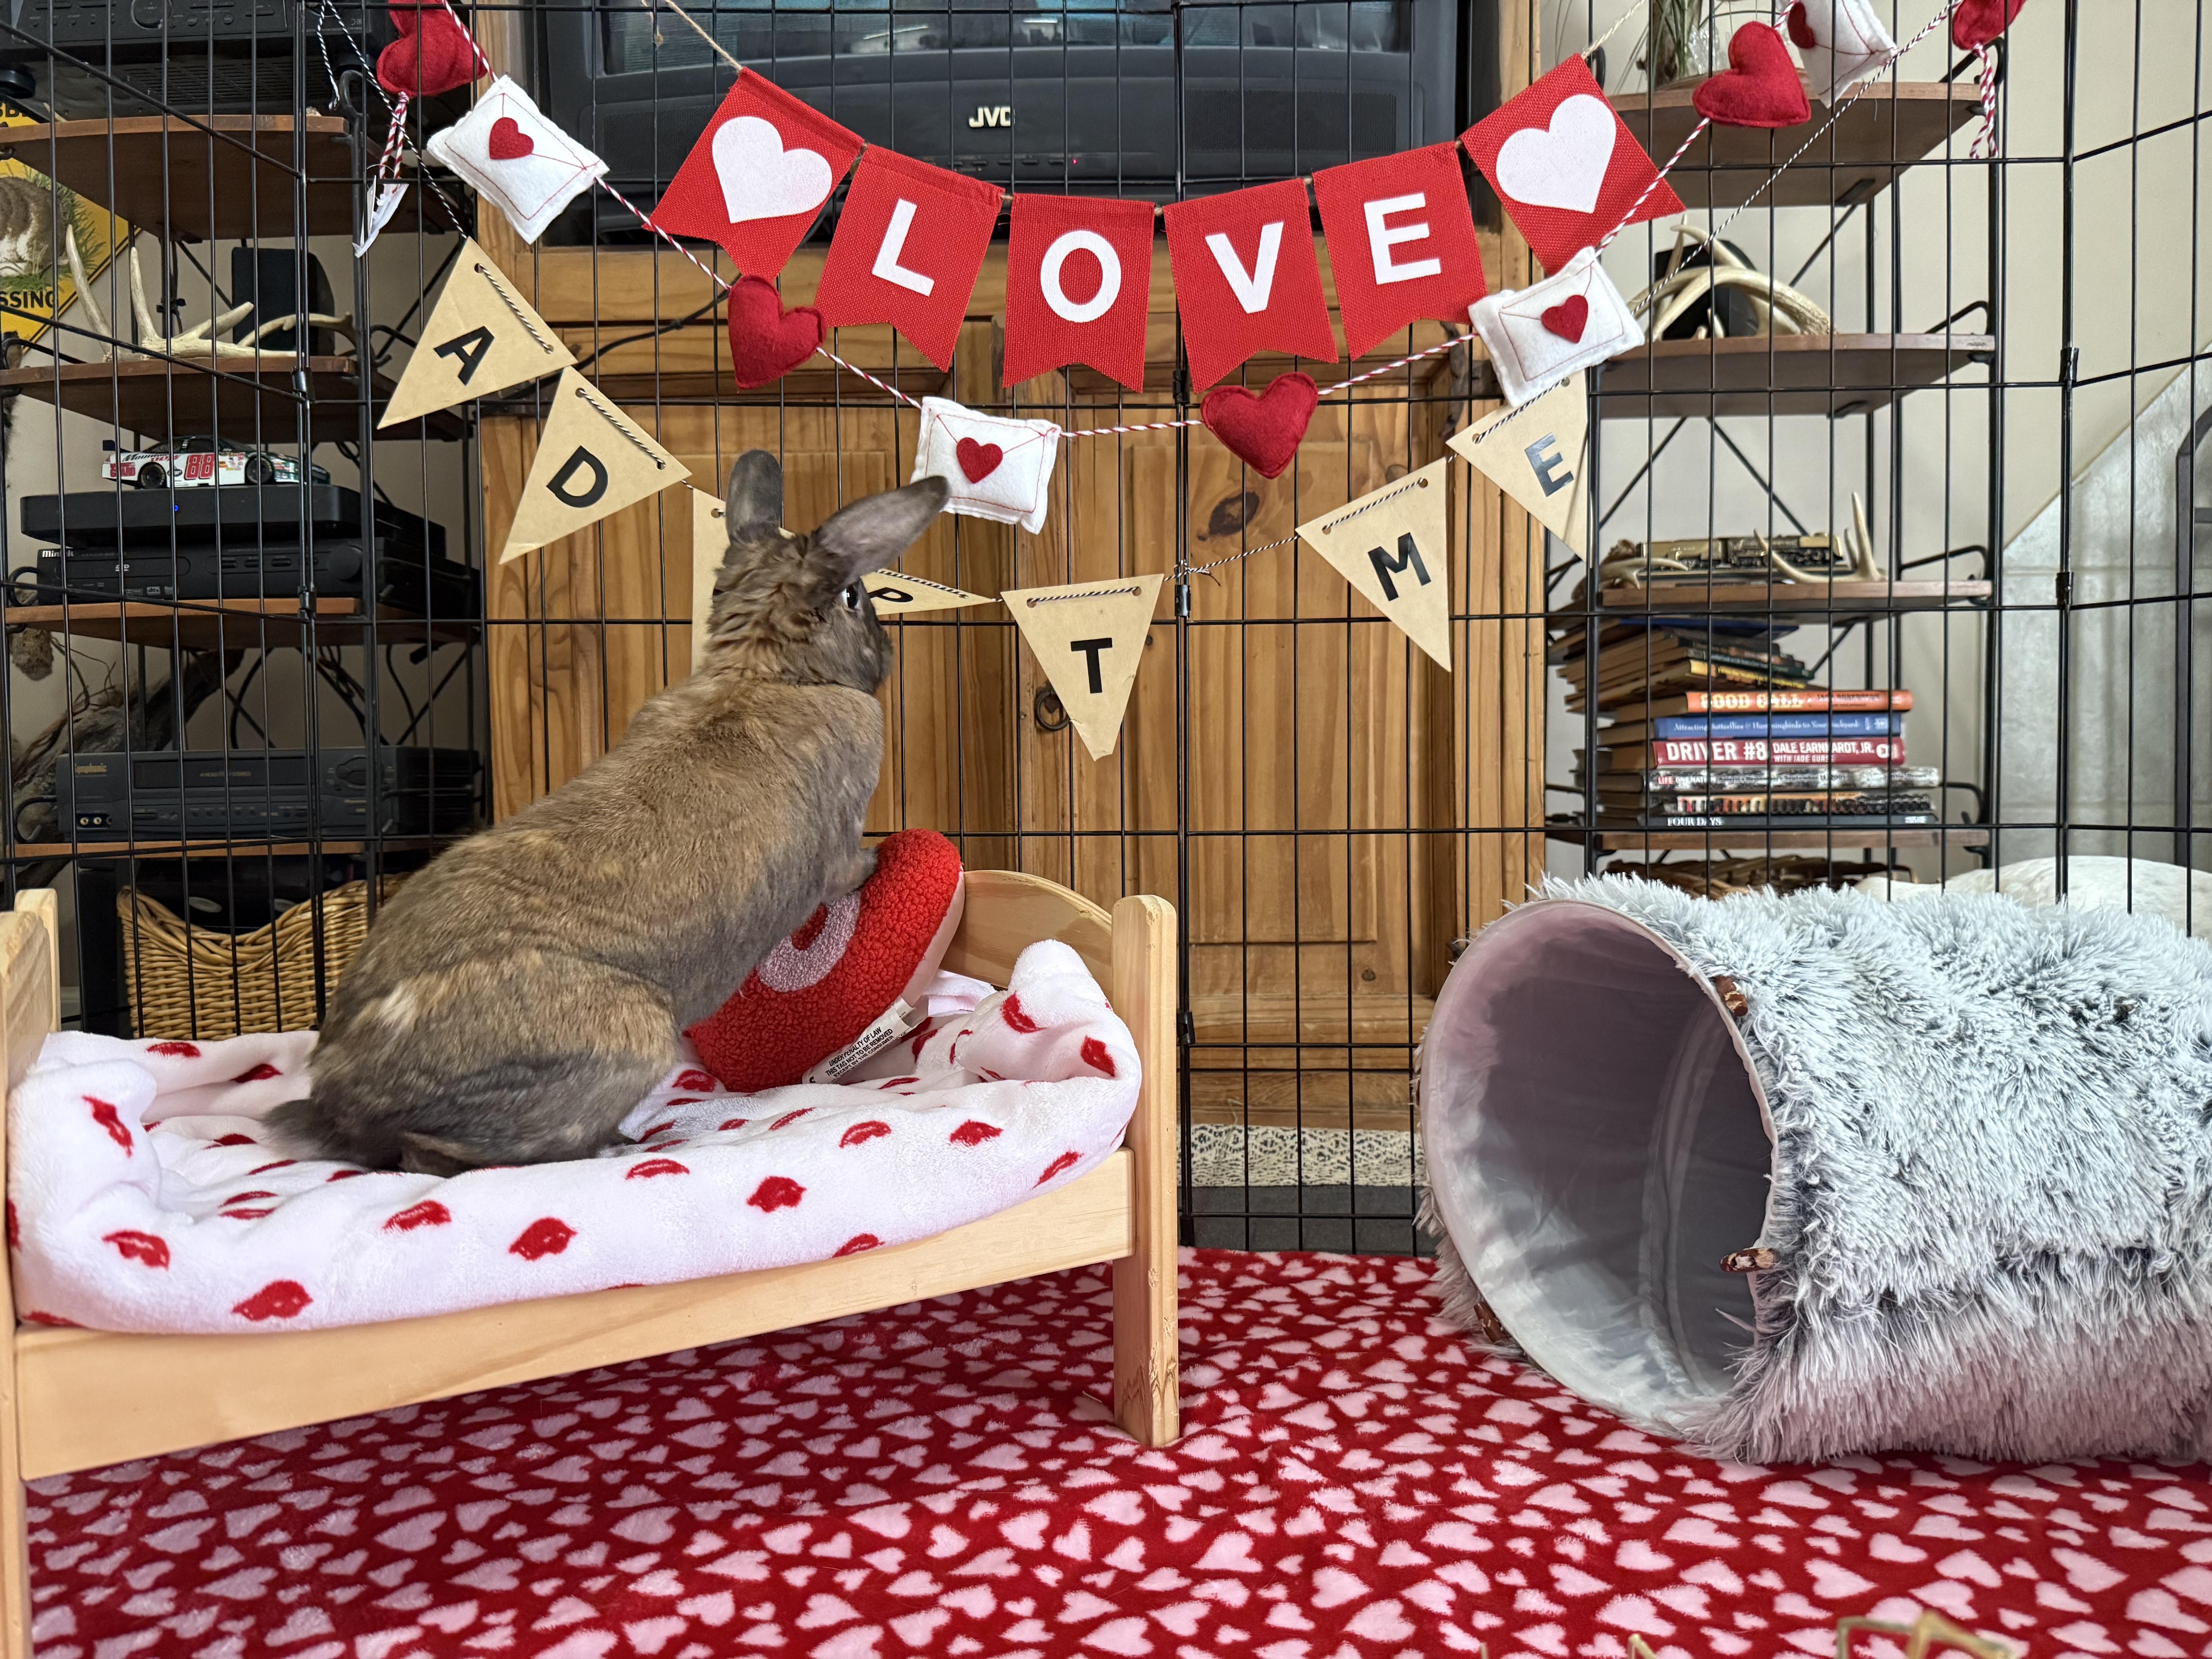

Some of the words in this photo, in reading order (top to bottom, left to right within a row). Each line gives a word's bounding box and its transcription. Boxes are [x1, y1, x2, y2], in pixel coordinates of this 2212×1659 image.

[969, 106, 1015, 128] JVC
[871, 192, 1441, 323] LOVE
[184, 453, 215, 480] 88
[434, 326, 1113, 694] ADPT
[1367, 432, 1575, 601] ME
[1674, 722, 1708, 731] Attracting
[1708, 721, 1744, 730] utterflies
[1829, 719, 1859, 730] ackyard
[1743, 741, 1769, 761] #8
[1772, 742, 1799, 754] DALE
[1860, 742, 1874, 754] JR.
[1773, 755, 1792, 763] WITH
[1667, 817, 1695, 826] FOUR
[825, 1068, 838, 1077] THIS
[836, 1061, 847, 1070] TAG
[847, 1054, 857, 1065] NOT
[855, 1049, 864, 1058] TO
[863, 1044, 871, 1053] BE
[871, 1028, 893, 1047] REMOVED
[828, 1054, 844, 1066] UNDER
[844, 1039, 864, 1058] PENALTY
[863, 1034, 871, 1043] OF
[870, 1027, 882, 1038] LAW
[858, 1053, 869, 1061] THE
[868, 1035, 895, 1056] CONSUMER
